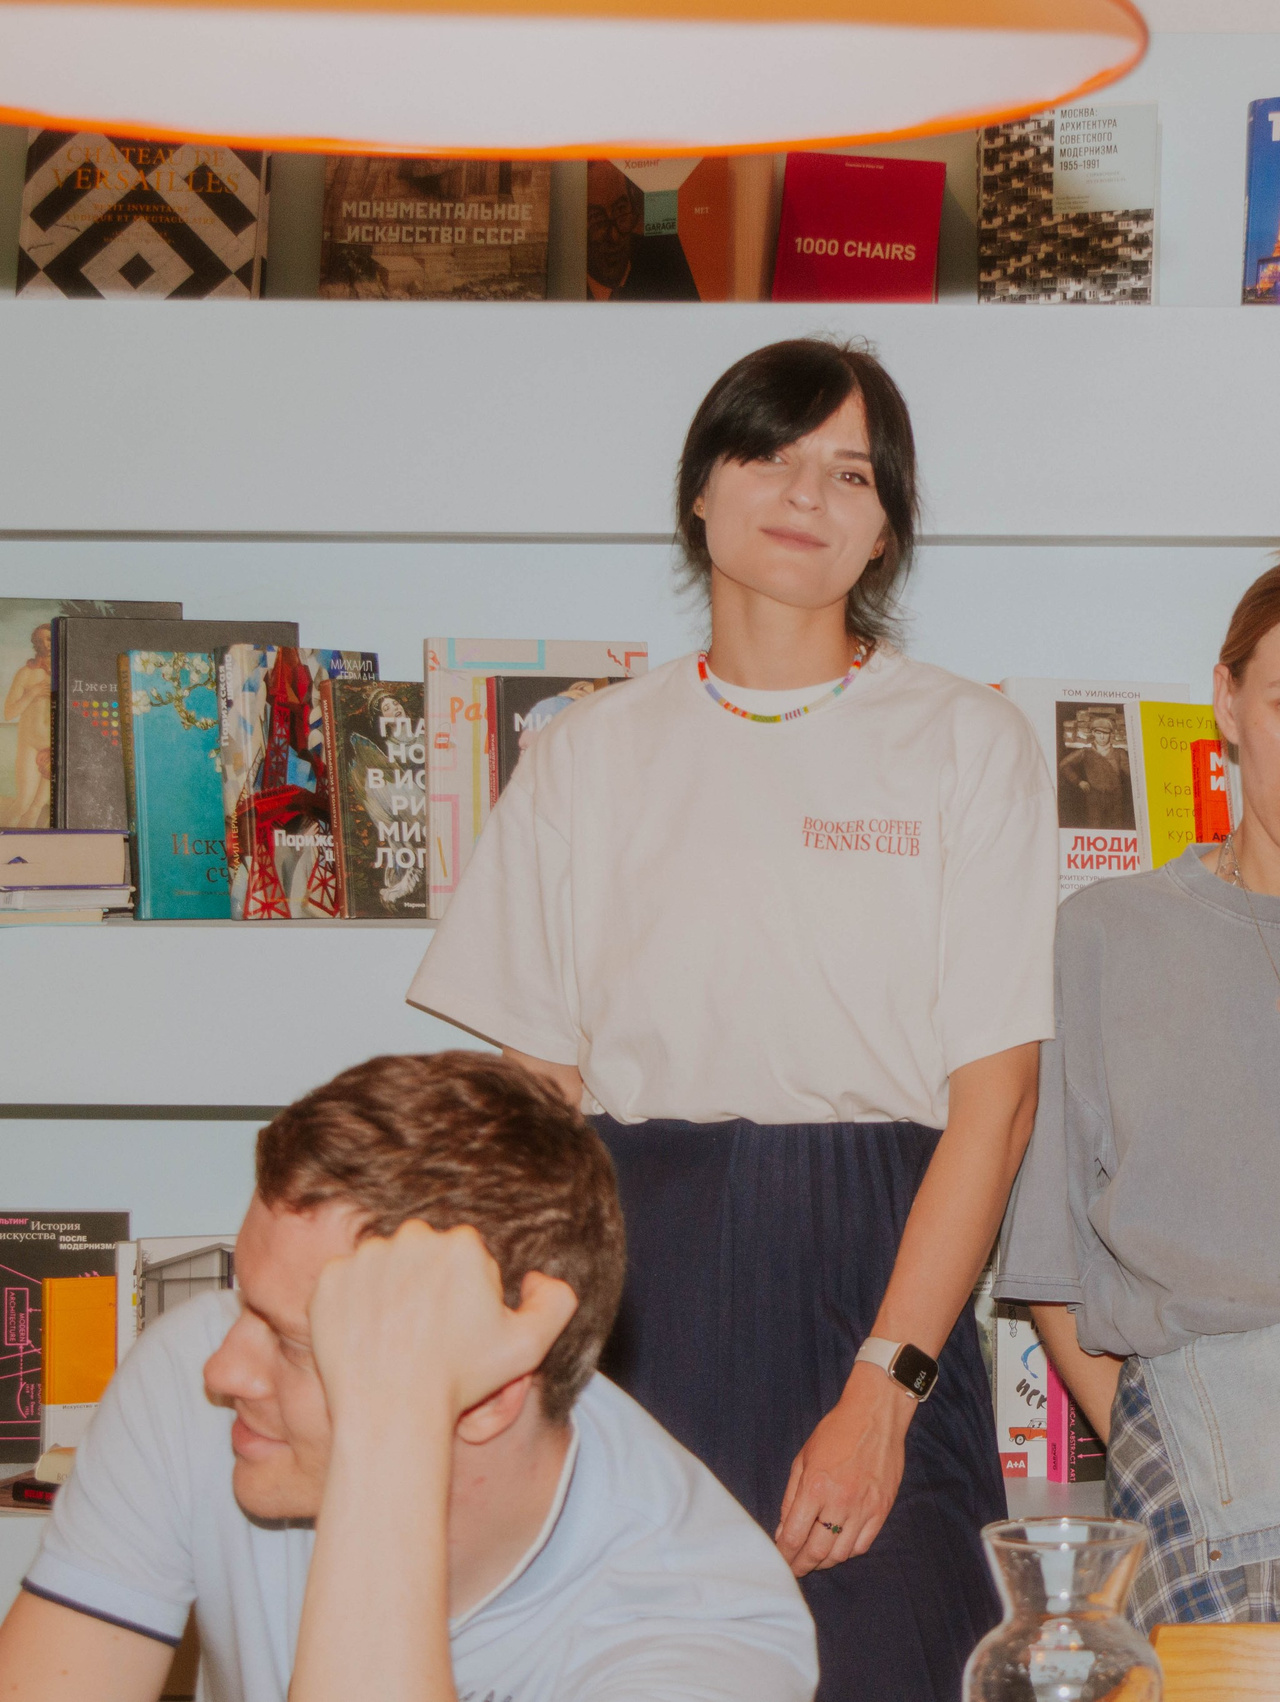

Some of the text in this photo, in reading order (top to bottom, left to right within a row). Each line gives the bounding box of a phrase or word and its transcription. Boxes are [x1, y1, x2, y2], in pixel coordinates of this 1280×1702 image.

[1060, 107, 1098, 119] МОСКВА:
[1060, 119, 1118, 132] АРХИТЕКТУРА
[1059, 132, 1113, 145] СОВЕТСКОГО
[66, 145, 184, 166] CHÂTEAU
[1059, 145, 1118, 158] МОДЕРНИЗМА
[54, 168, 240, 194] VERSAILLES
[342, 201, 533, 221] МОНУМЕНТАЛЬНОЕ
[347, 225, 526, 245] ИСКУССТВО СССР
[645, 222, 676, 232] GARAGE
[795, 237, 917, 262] 1000 CHAIRS
[331, 659, 372, 672] МИХАИЛ
[72, 679, 118, 694] Джен
[1062, 689, 1141, 699] ТОМ УИЛКИНСОН
[219, 666, 230, 748] Парижская
[450, 697, 489, 724] Ра
[1158, 714, 1193, 728] Ханс
[368, 768, 385, 789] В
[378, 822, 426, 842] МИ
[803, 816, 922, 836] BOOKER COFFEE
[274, 830, 334, 851] Парижс
[802, 830, 920, 857] TENNIS CLUB
[1071, 836, 1138, 853] ЛЮДИ
[1067, 854, 1141, 871] КИРПИ
[31, 1221, 81, 1233] История
[0, 1231, 56, 1242] искусства
[8, 1291, 16, 1342] ARCHITECTURE
[19, 1312, 27, 1343] MODERN
[1006, 1460, 1025, 1469] A+A
